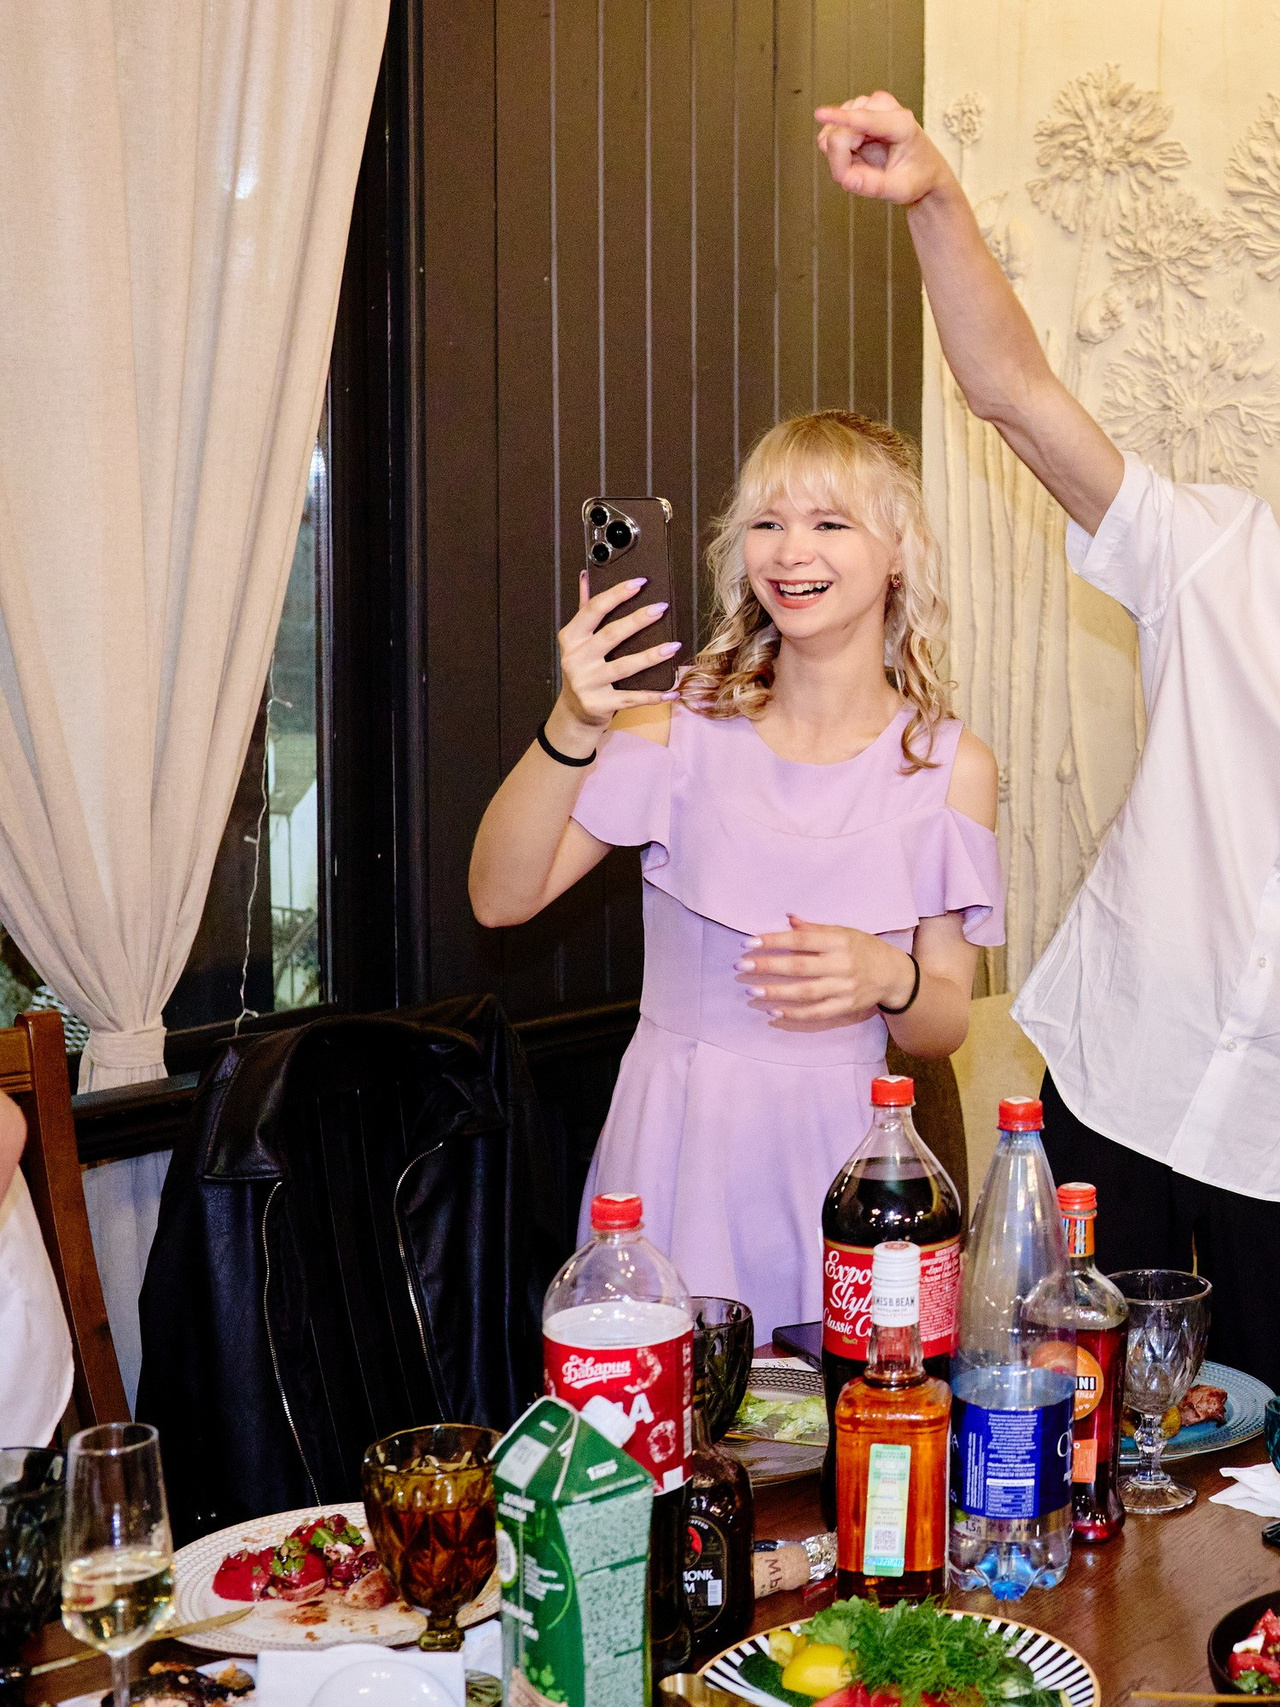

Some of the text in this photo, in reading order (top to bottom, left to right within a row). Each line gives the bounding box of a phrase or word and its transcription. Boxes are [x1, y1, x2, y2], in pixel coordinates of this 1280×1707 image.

[825, 1250, 873, 1296] Expo
[829, 1281, 873, 1320] Styl
[562, 1354, 632, 1384] Бавария
